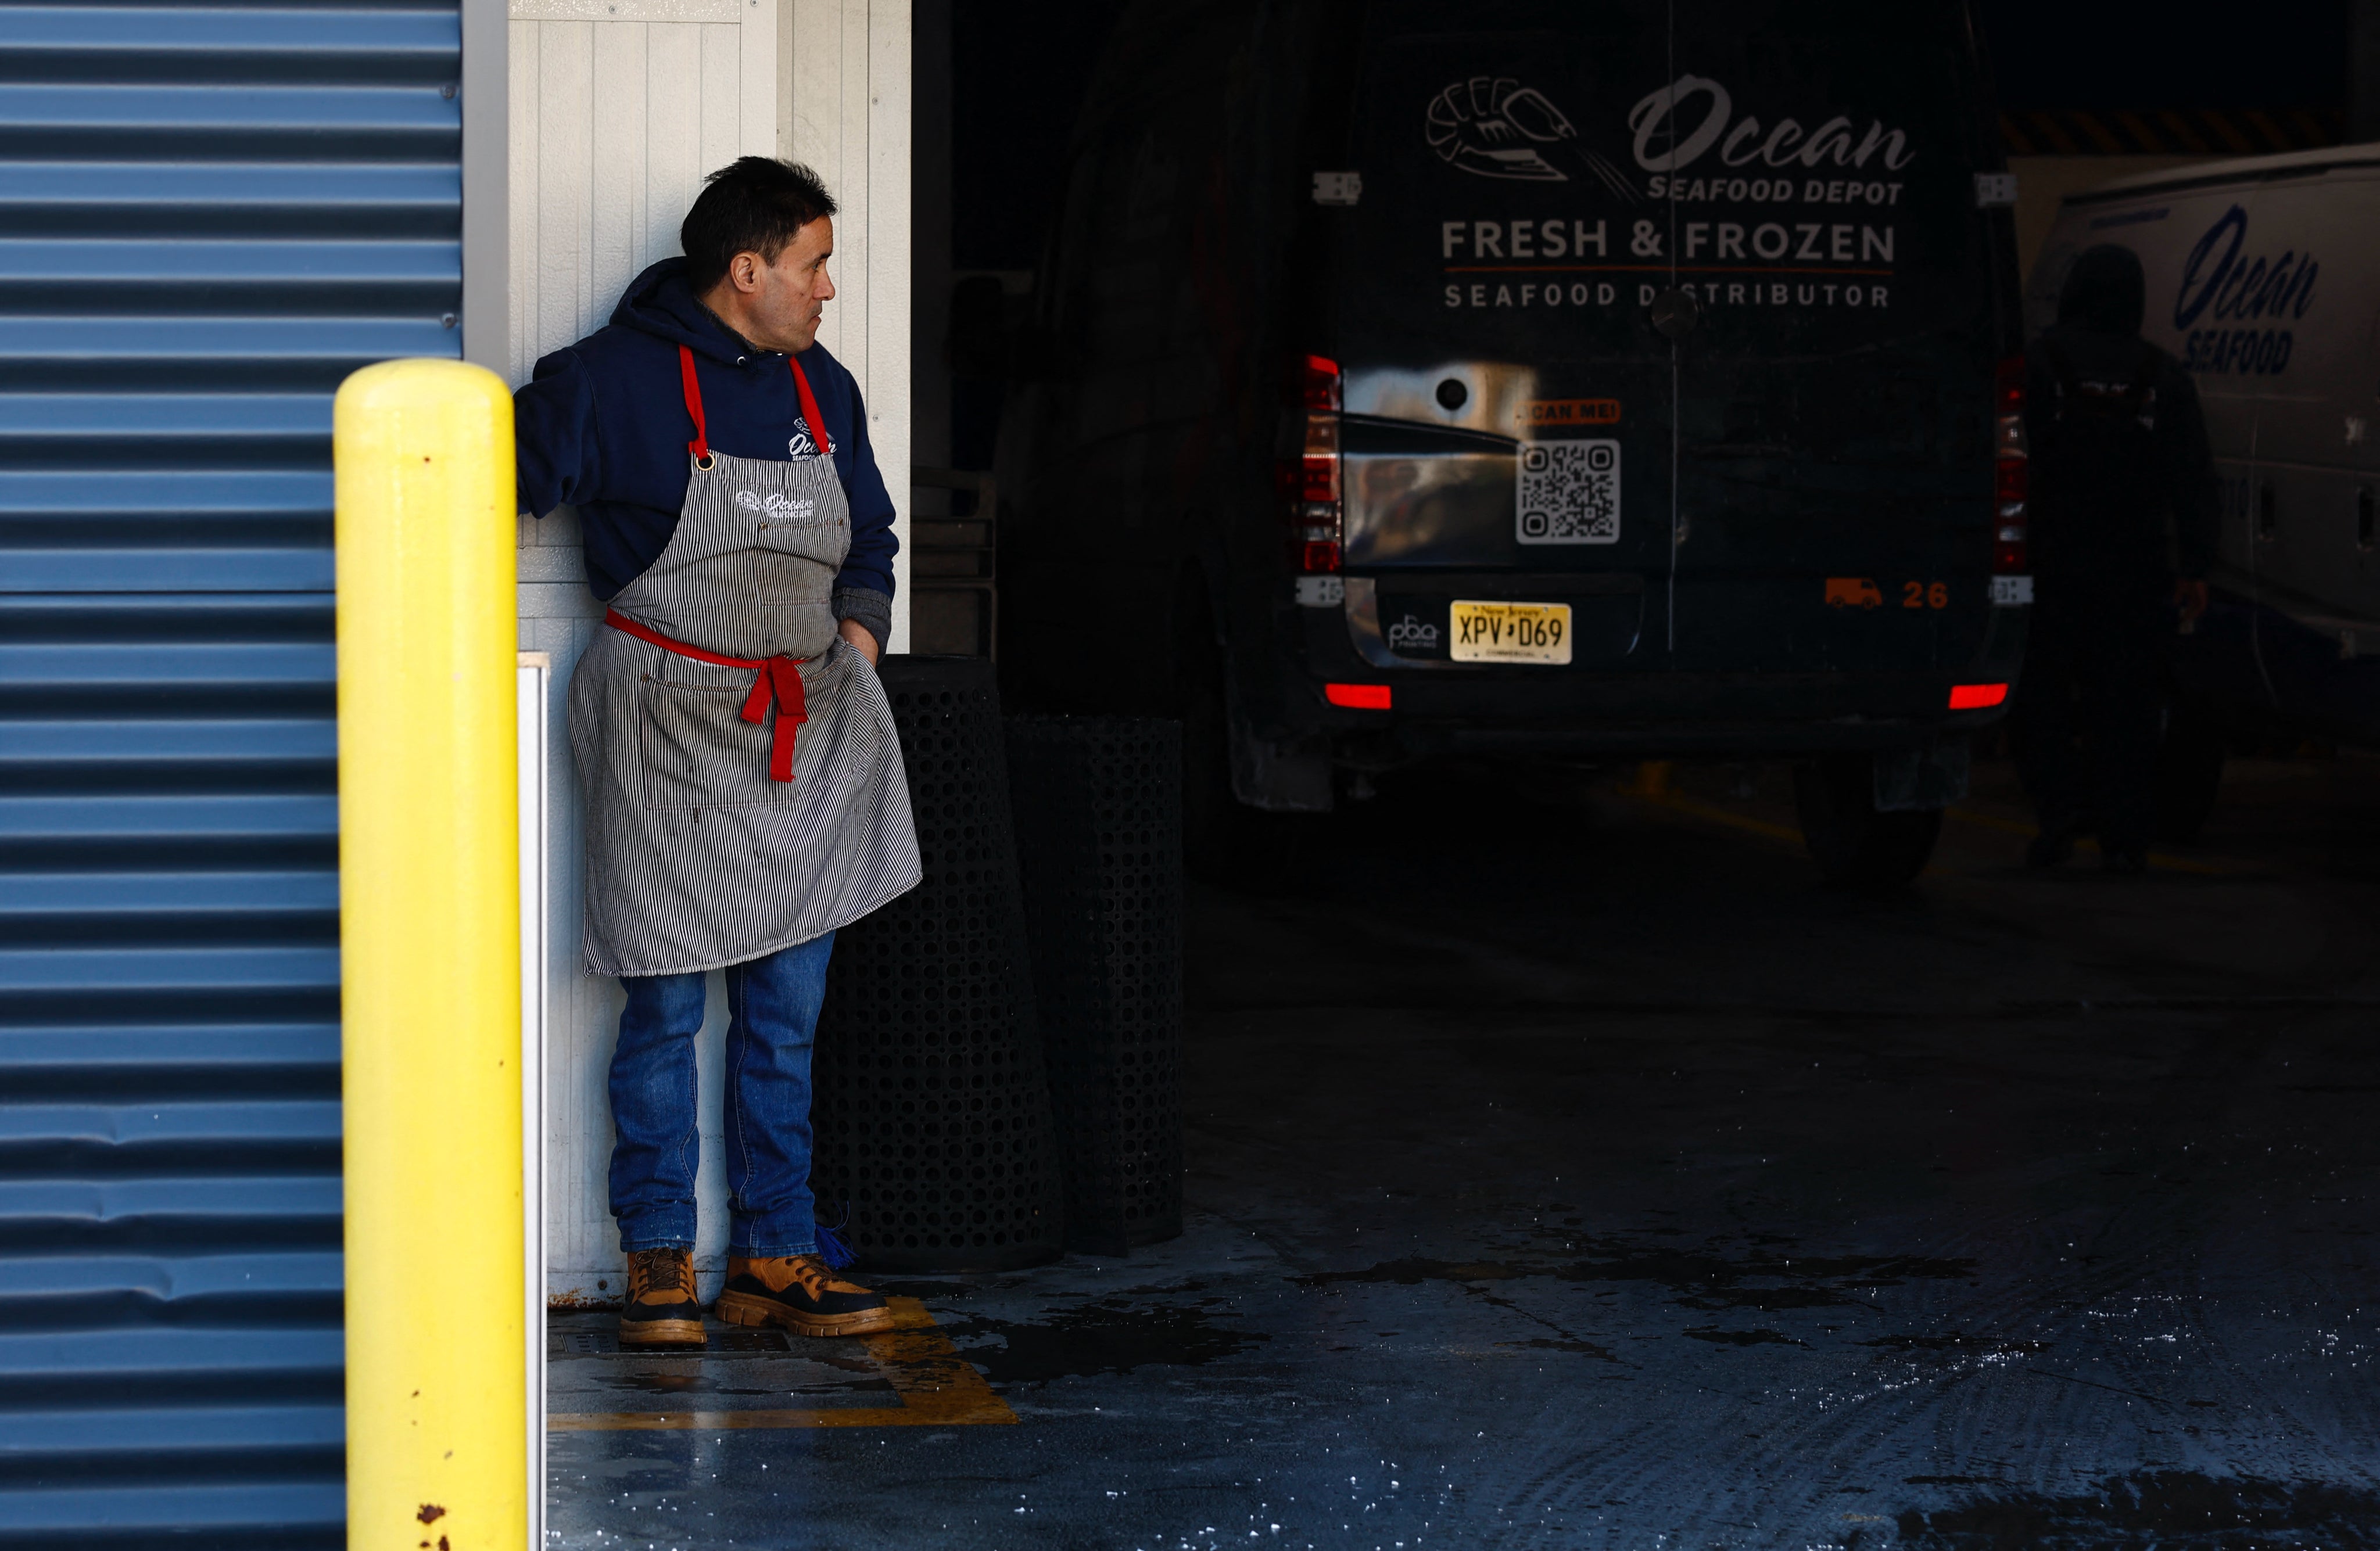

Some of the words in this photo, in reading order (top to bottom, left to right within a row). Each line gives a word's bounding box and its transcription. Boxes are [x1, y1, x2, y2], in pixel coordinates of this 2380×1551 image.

[1628, 73, 1917, 172] Ocean
[1647, 177, 1794, 203] SEAFOOD
[1804, 180, 1904, 206] DEPOT
[1442, 219, 1607, 258] FRESH
[1630, 219, 1664, 257] &
[1686, 221, 1895, 263] FROZEN
[2175, 204, 2318, 331] Ocean
[1445, 283, 1616, 307] SEAFOOD
[1638, 283, 1889, 307] DTRIBUTOR
[2183, 330, 2292, 374] SEAFOOD
[1580, 402, 1615, 418] ME!
[789, 433, 837, 455] Ocen
[765, 494, 813, 511] Ocean
[1902, 580, 1948, 610] 26
